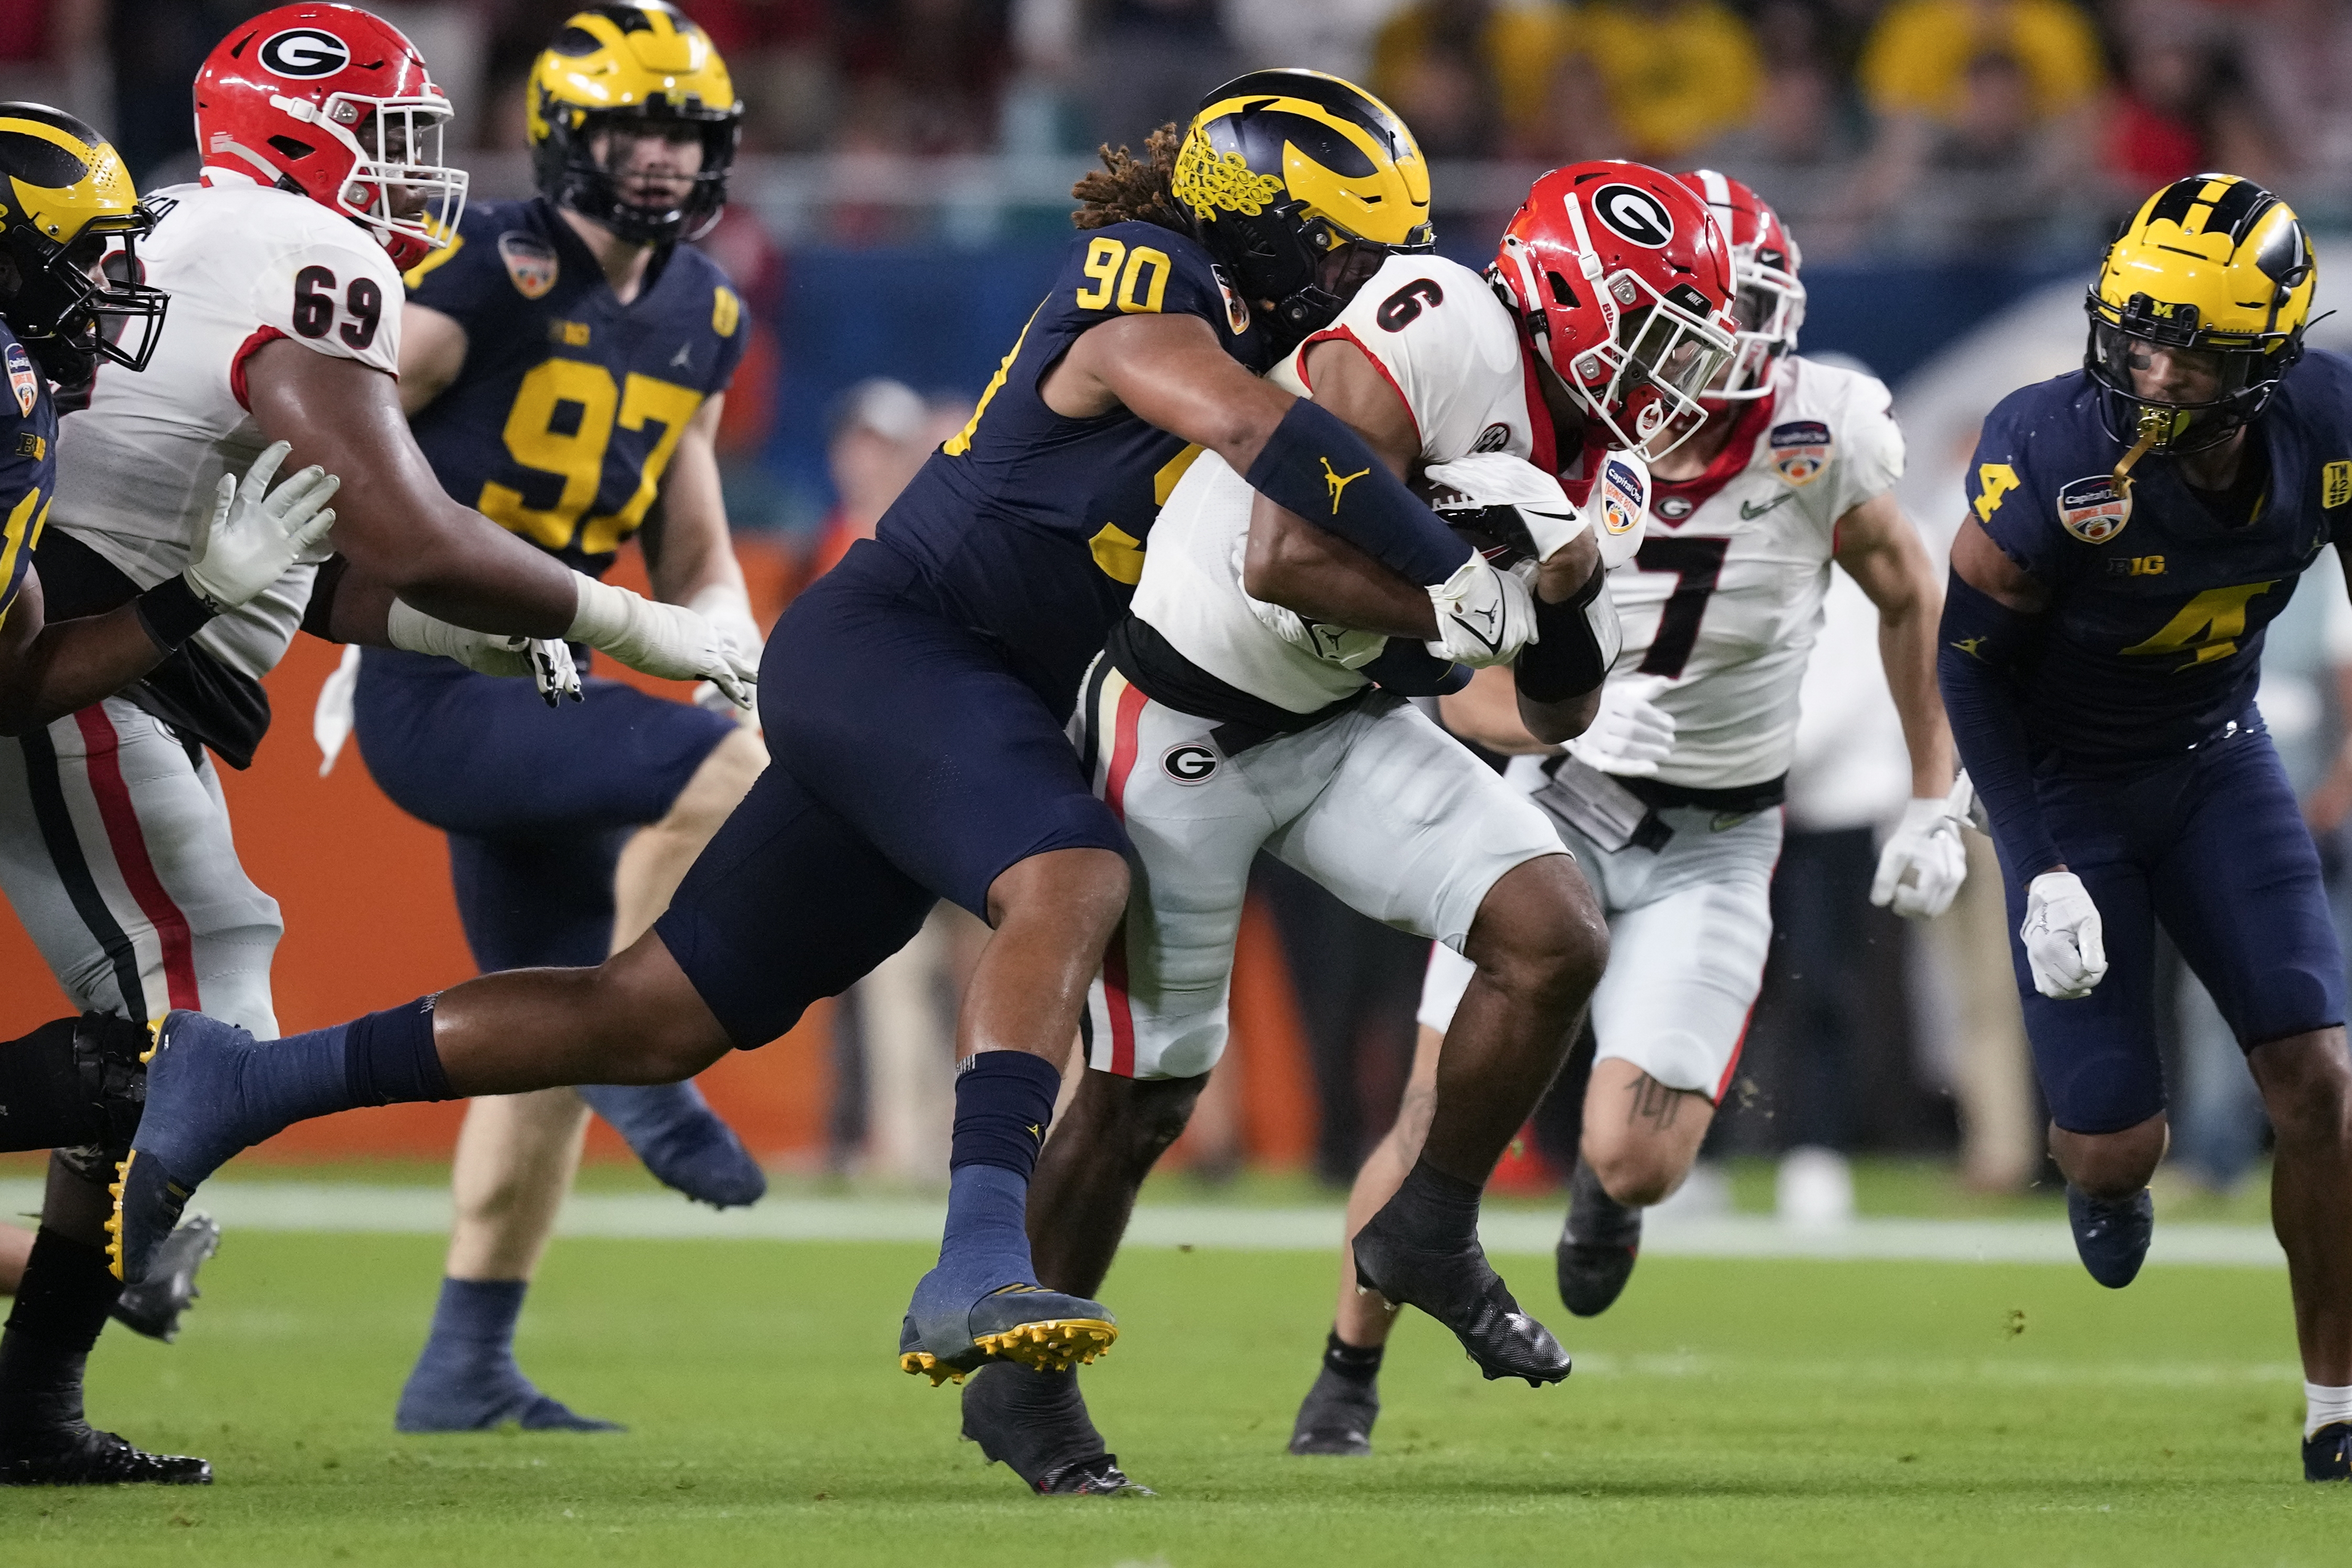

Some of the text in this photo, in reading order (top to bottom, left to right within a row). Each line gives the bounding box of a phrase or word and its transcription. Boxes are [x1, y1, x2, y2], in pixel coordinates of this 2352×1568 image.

[260, 28, 349, 79] G
[1593, 184, 1674, 248] G
[1076, 237, 1171, 313] 90
[1685, 291, 1704, 306] NIKE
[292, 265, 382, 350] 69
[1377, 278, 1443, 332] 6
[2151, 301, 2174, 319] M
[478, 358, 703, 554] 97
[1974, 463, 2020, 522] 4
[2329, 479, 2349, 493] 42
[1635, 538, 1730, 680] 7
[2118, 580, 2282, 674] 4
[1163, 744, 1218, 782] G
